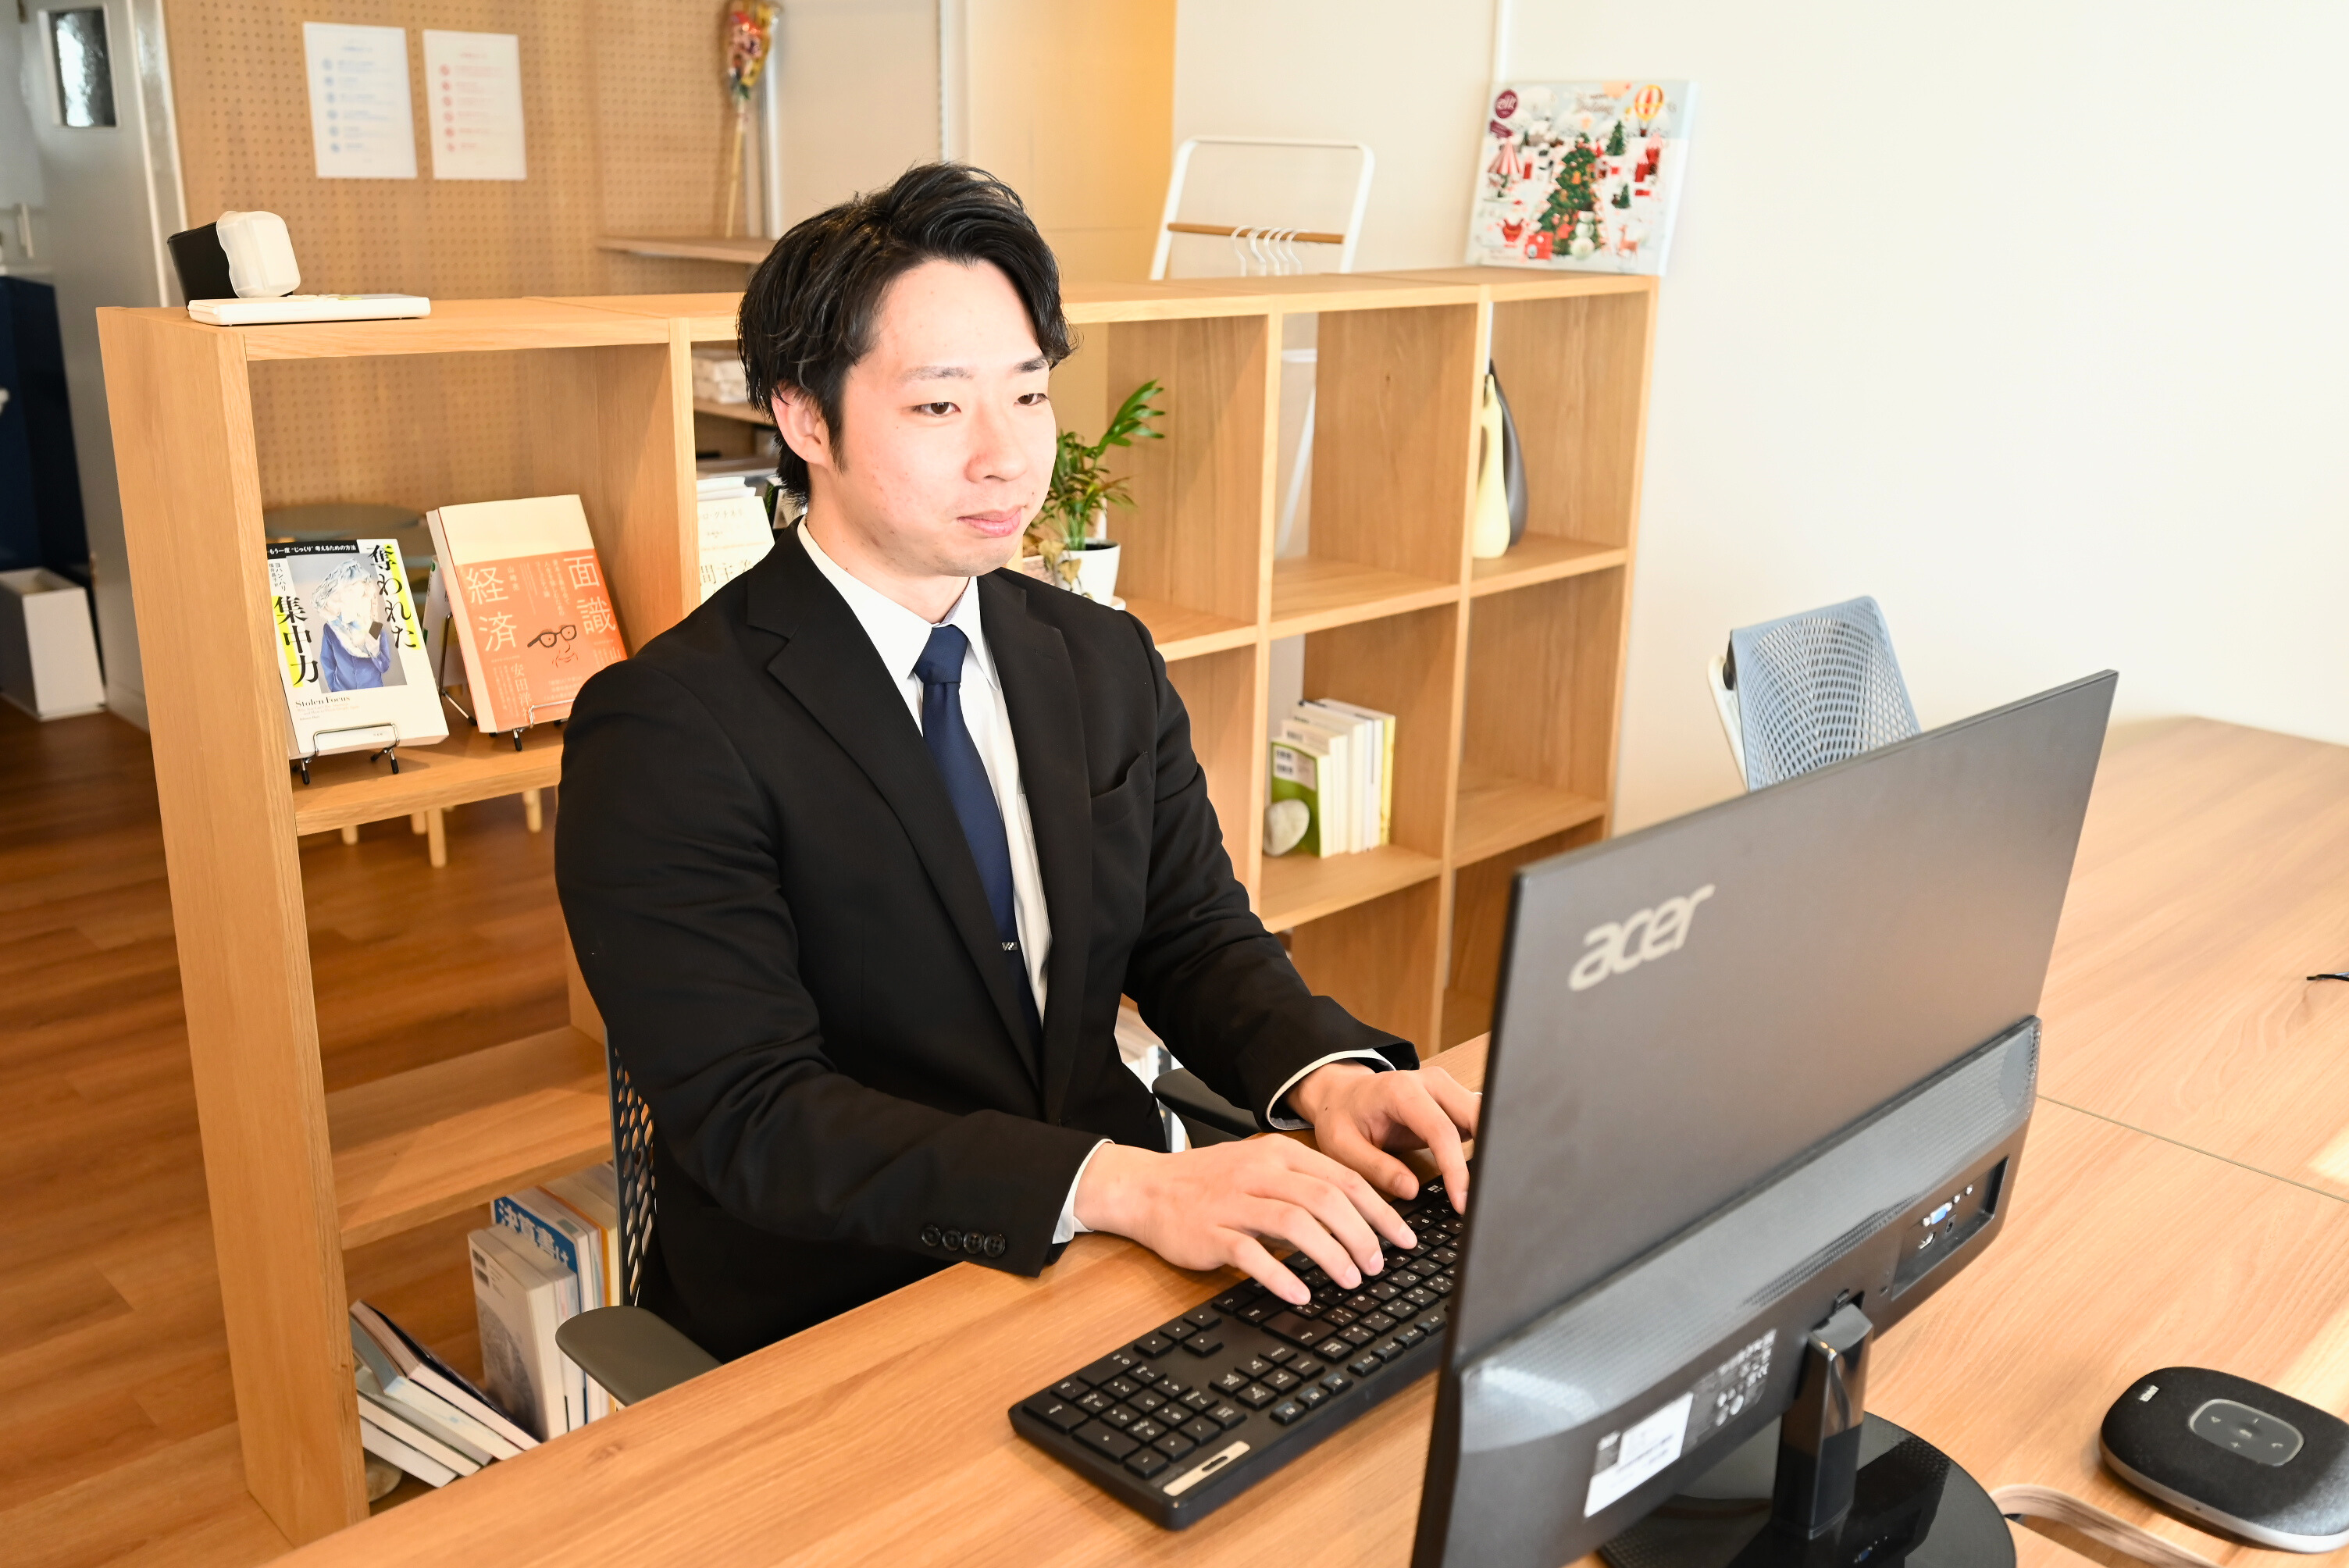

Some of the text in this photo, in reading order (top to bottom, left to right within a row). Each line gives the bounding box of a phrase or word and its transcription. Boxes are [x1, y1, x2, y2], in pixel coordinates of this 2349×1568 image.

[366, 544, 416, 649] 奪われた
[466, 566, 518, 652] 経済
[563, 554, 616, 636] 面識
[273, 596, 319, 686] 集中力
[295, 698, 324, 707] Stolen
[1567, 883, 1716, 992] acer
